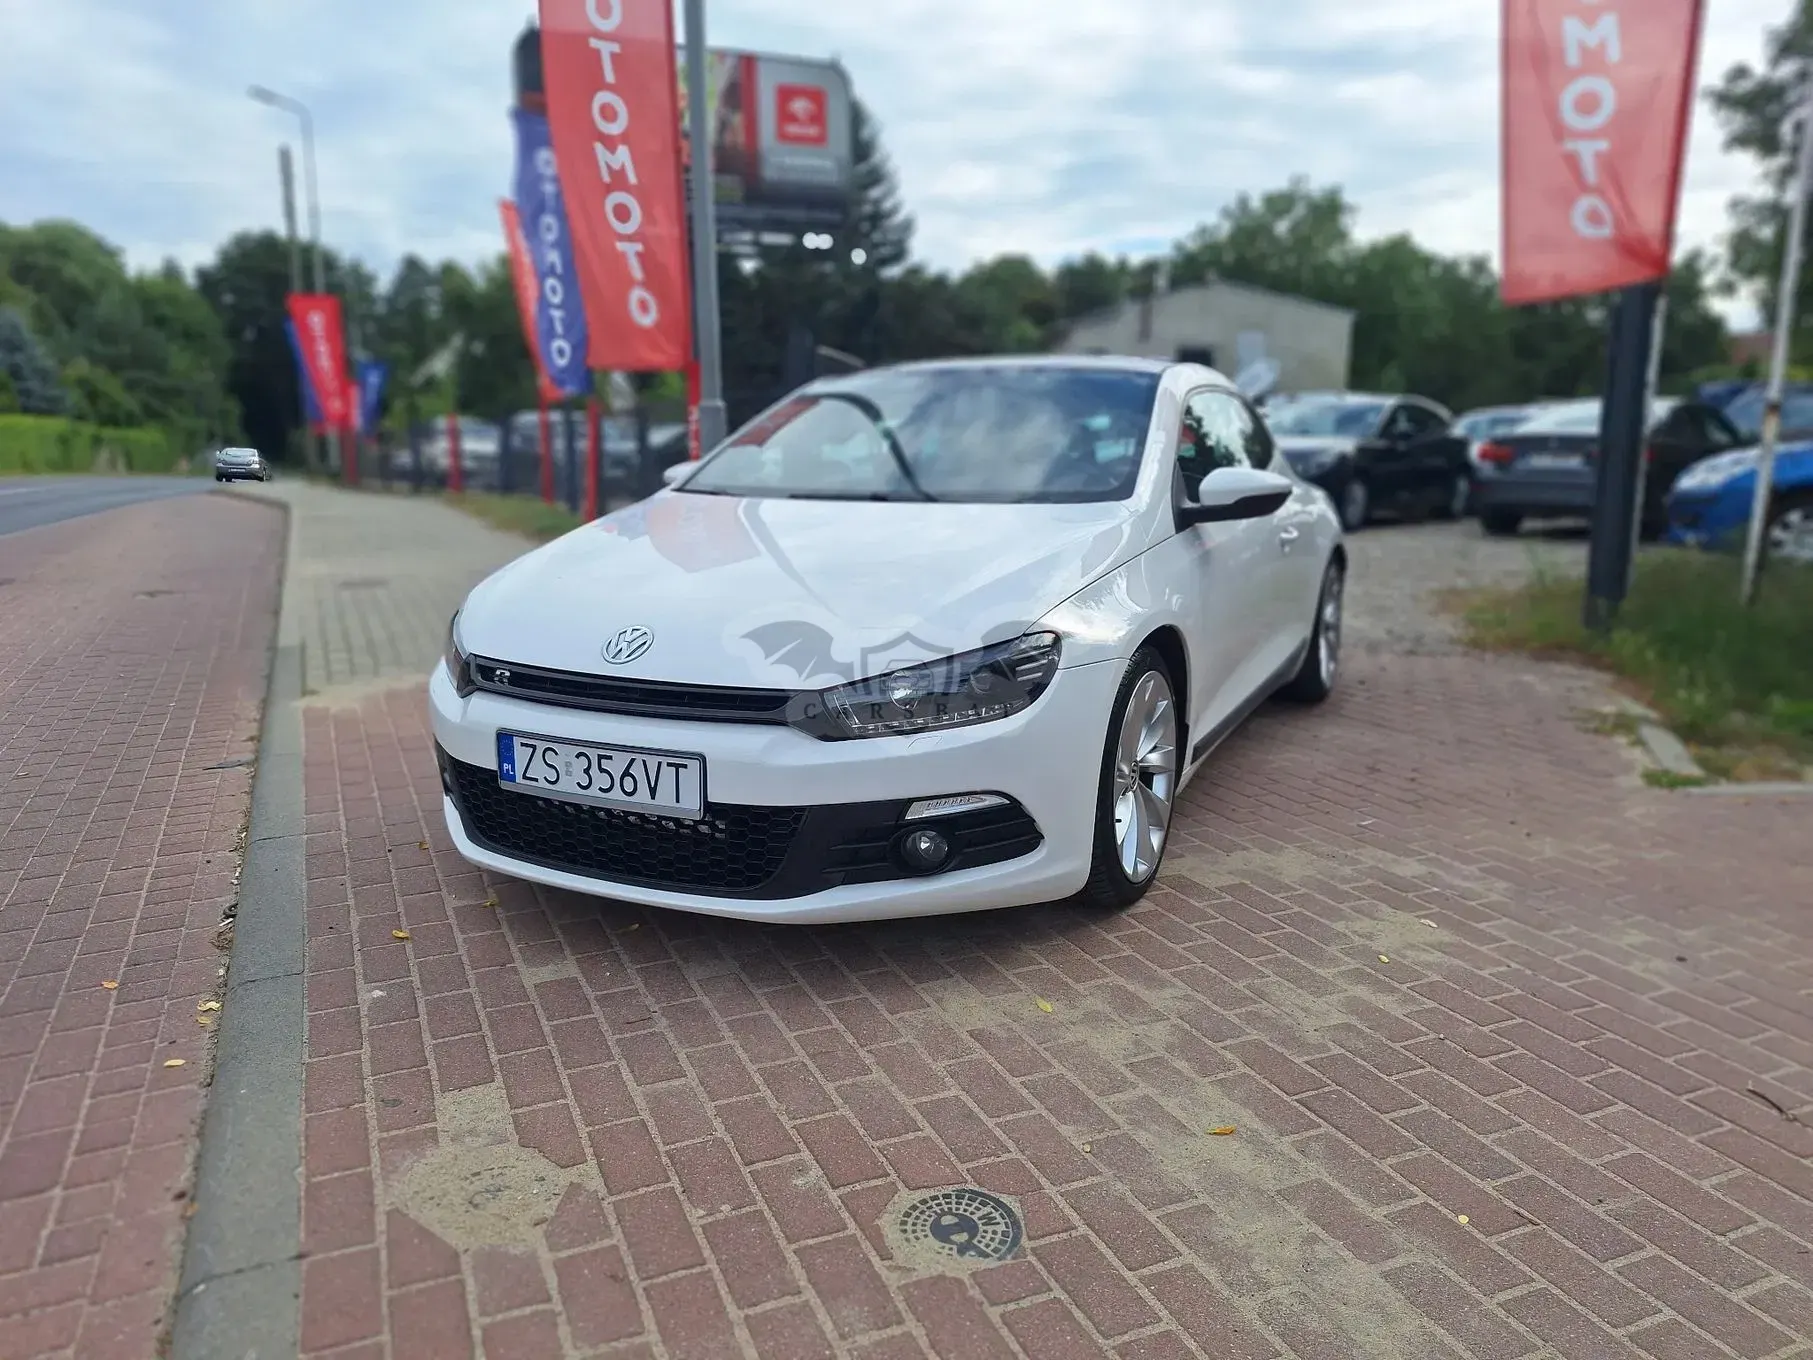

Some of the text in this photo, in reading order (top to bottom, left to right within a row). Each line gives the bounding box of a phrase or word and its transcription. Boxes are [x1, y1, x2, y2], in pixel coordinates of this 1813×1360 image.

[585, 0, 660, 328] OTOMOTO
[1558, 0, 1623, 240] MOTO
[503, 763, 514, 775] PL
[520, 741, 688, 803] ZS 356VT
